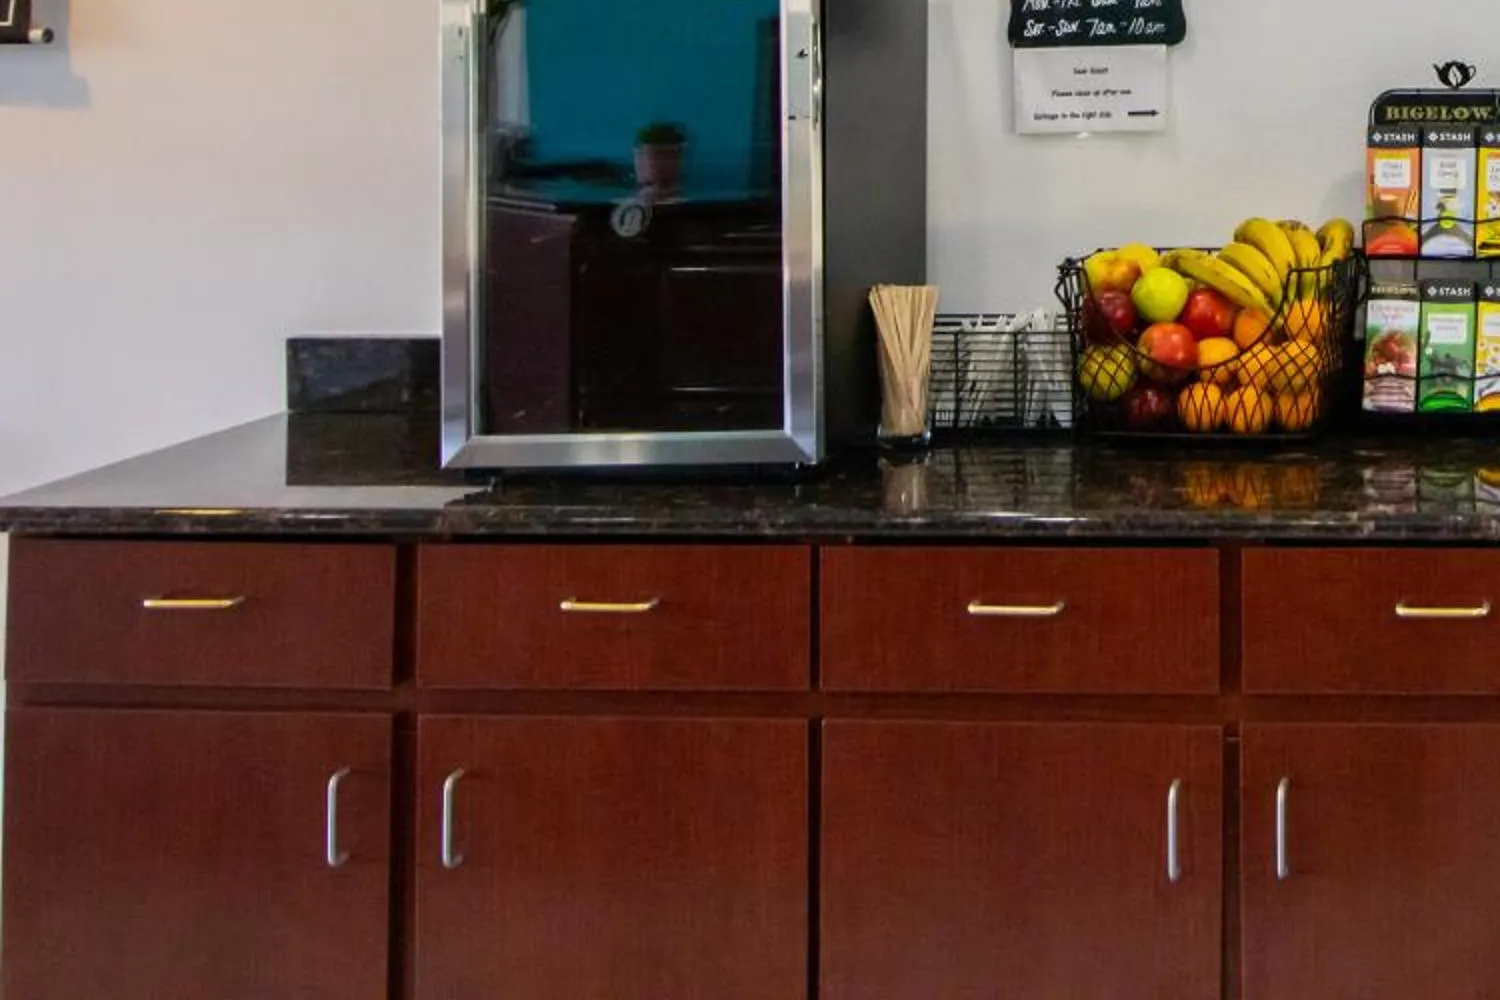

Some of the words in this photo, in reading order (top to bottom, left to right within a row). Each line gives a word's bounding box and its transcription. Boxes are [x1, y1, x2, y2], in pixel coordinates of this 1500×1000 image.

[1386, 105, 1491, 120] BIGELOW
[1384, 133, 1415, 142] STASH
[1439, 133, 1471, 141] STASH
[1439, 288, 1471, 296] STASH
